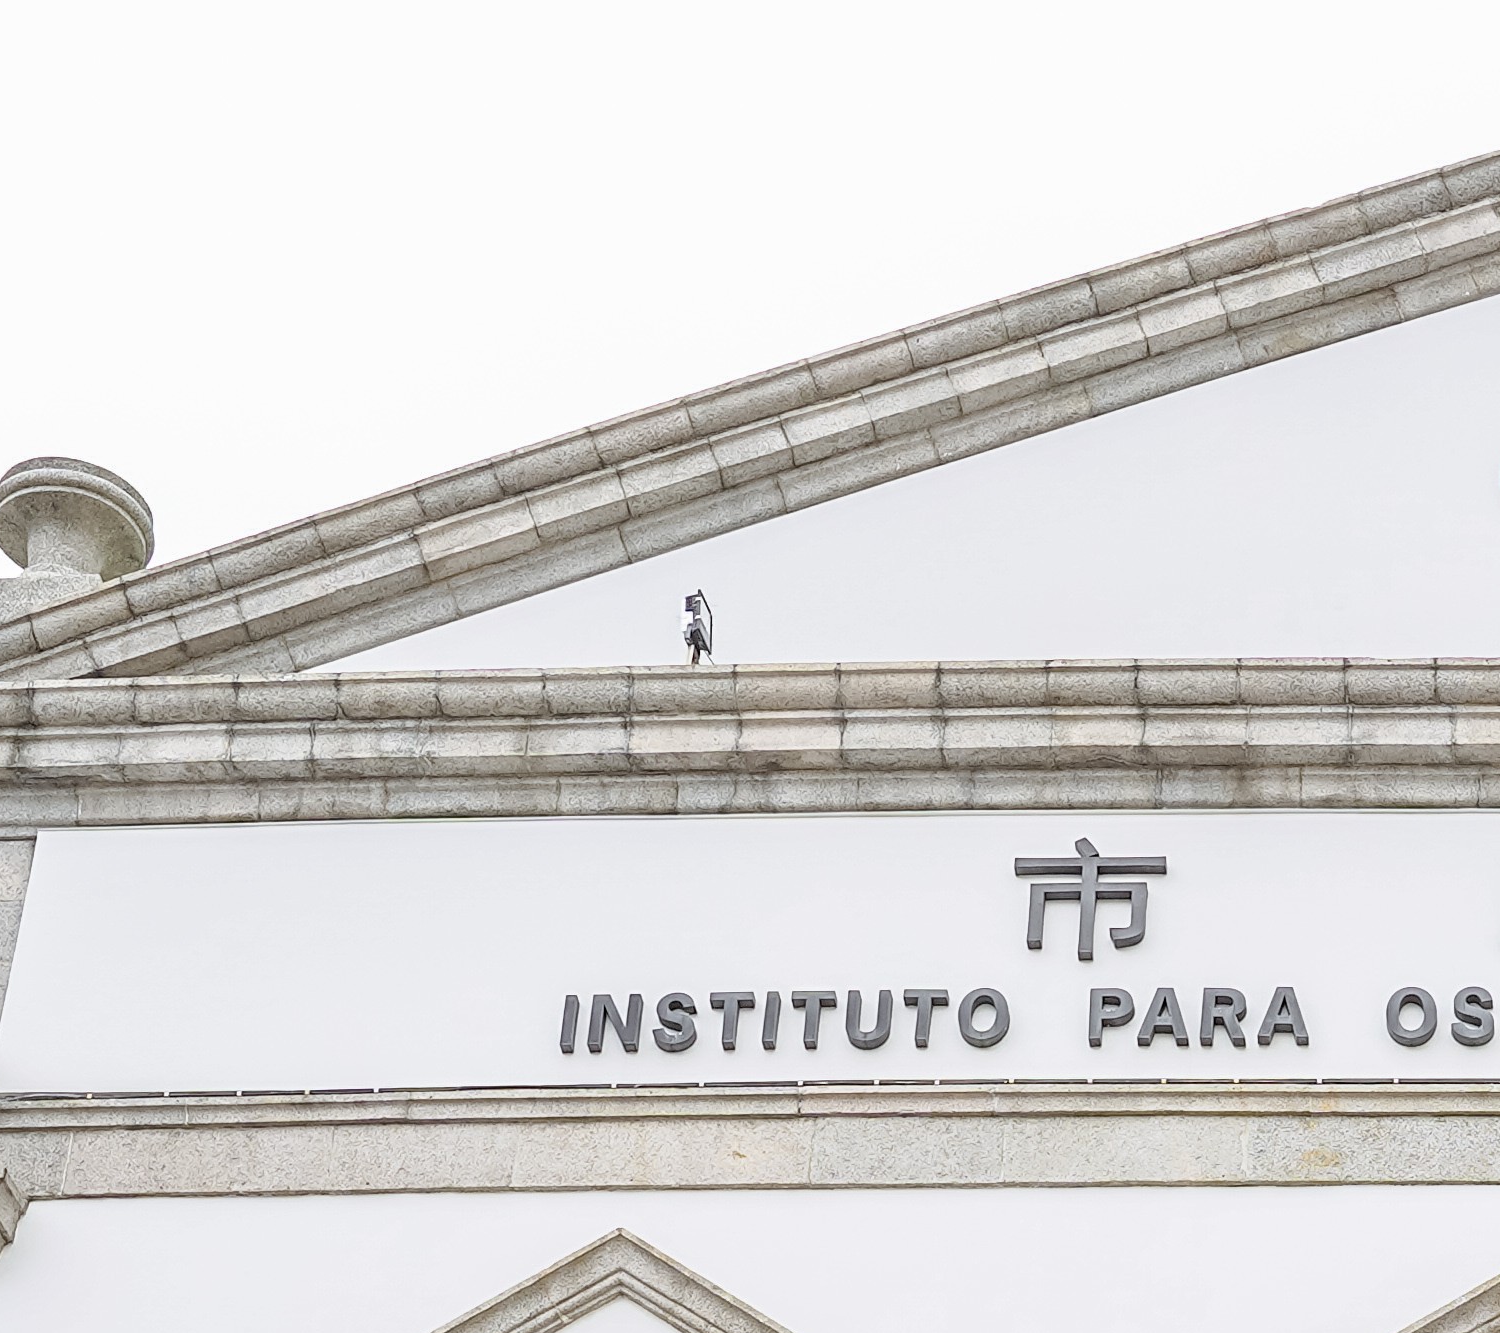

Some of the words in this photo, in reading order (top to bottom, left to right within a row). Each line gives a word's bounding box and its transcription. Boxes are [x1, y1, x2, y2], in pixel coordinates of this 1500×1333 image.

[558, 987, 1012, 1055] INSTITUTO
[1087, 985, 1311, 1049] PARA
[1384, 985, 1496, 1049] OS
